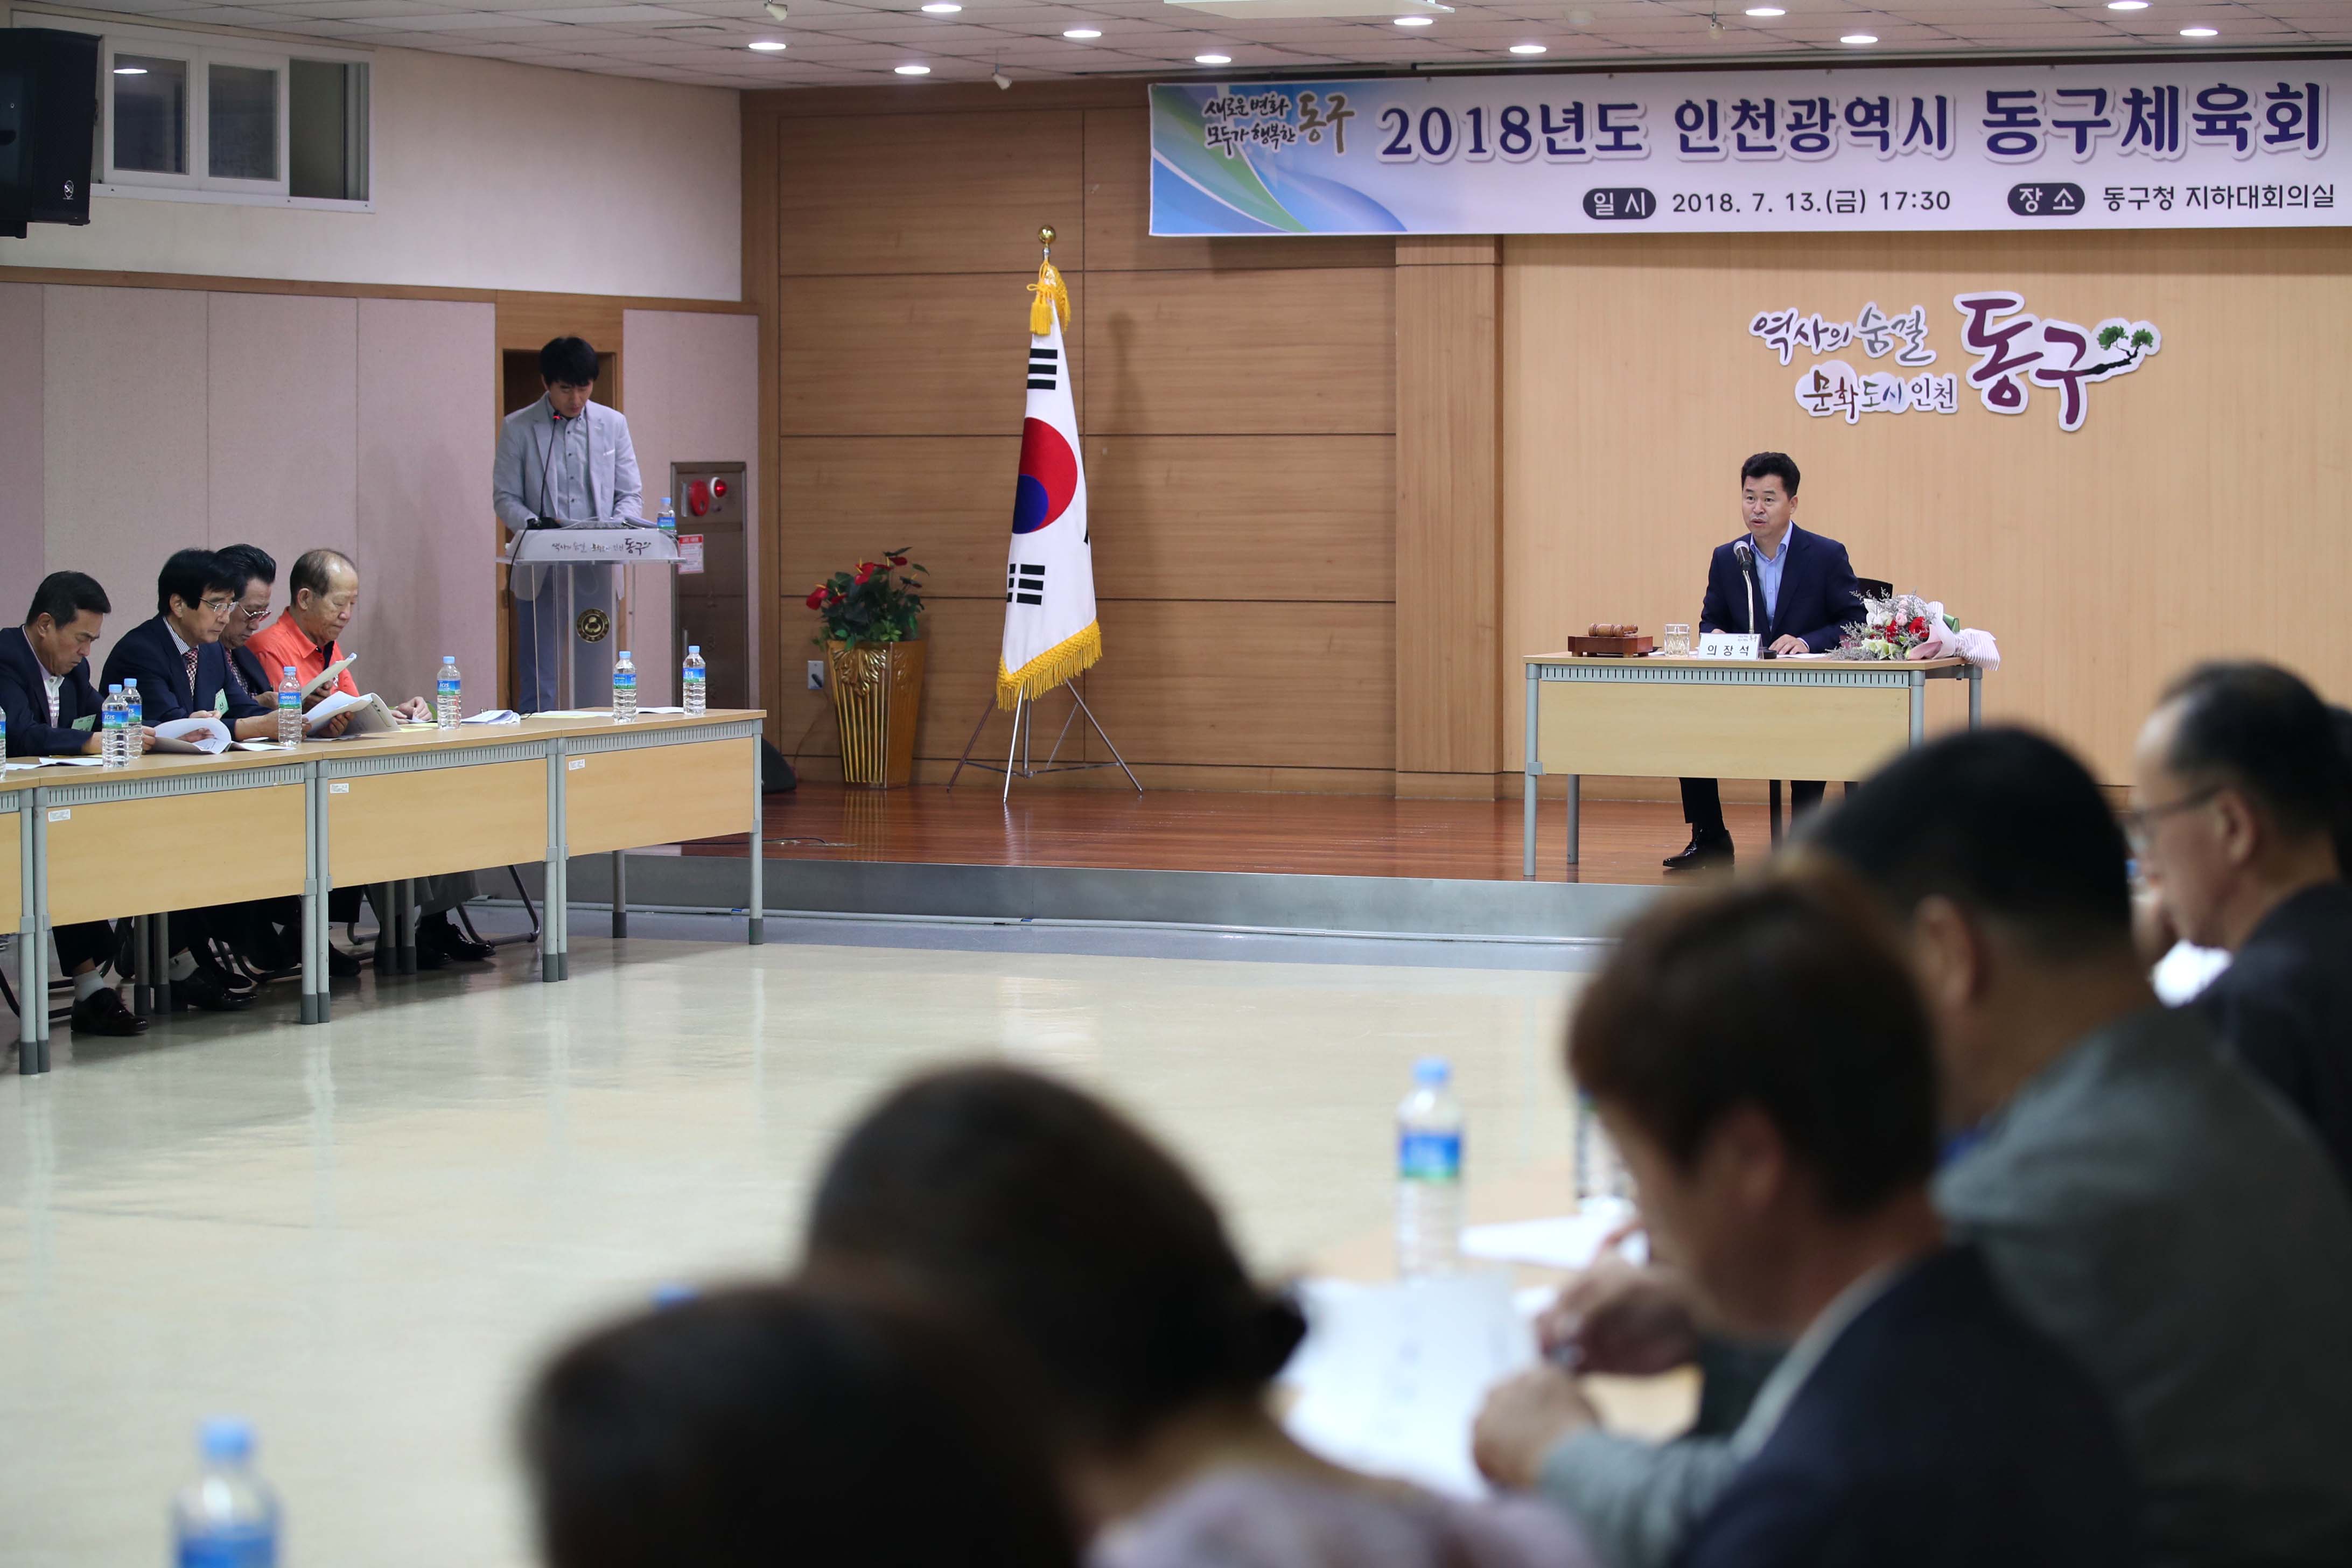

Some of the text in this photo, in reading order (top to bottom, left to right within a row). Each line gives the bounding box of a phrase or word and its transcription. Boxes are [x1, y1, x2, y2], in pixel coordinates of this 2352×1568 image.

[1205, 95, 1288, 121] 새로운 변화
[1299, 93, 1355, 153] 동구
[1381, 82, 2320, 155] 2018년도 인천광역시 동구체육회
[1207, 123, 1296, 156] 모두가 행복한
[1593, 189, 1950, 216] 일시 2018. 7. 13.(금) 17:30
[2019, 184, 2334, 212] 장소 동구청 지하대회의실
[1753, 306, 1932, 362] 역사의 숨결
[1961, 298, 2092, 425] 동구
[1803, 369, 1954, 419] 문화도시 인천
[625, 538, 642, 556] 동구
